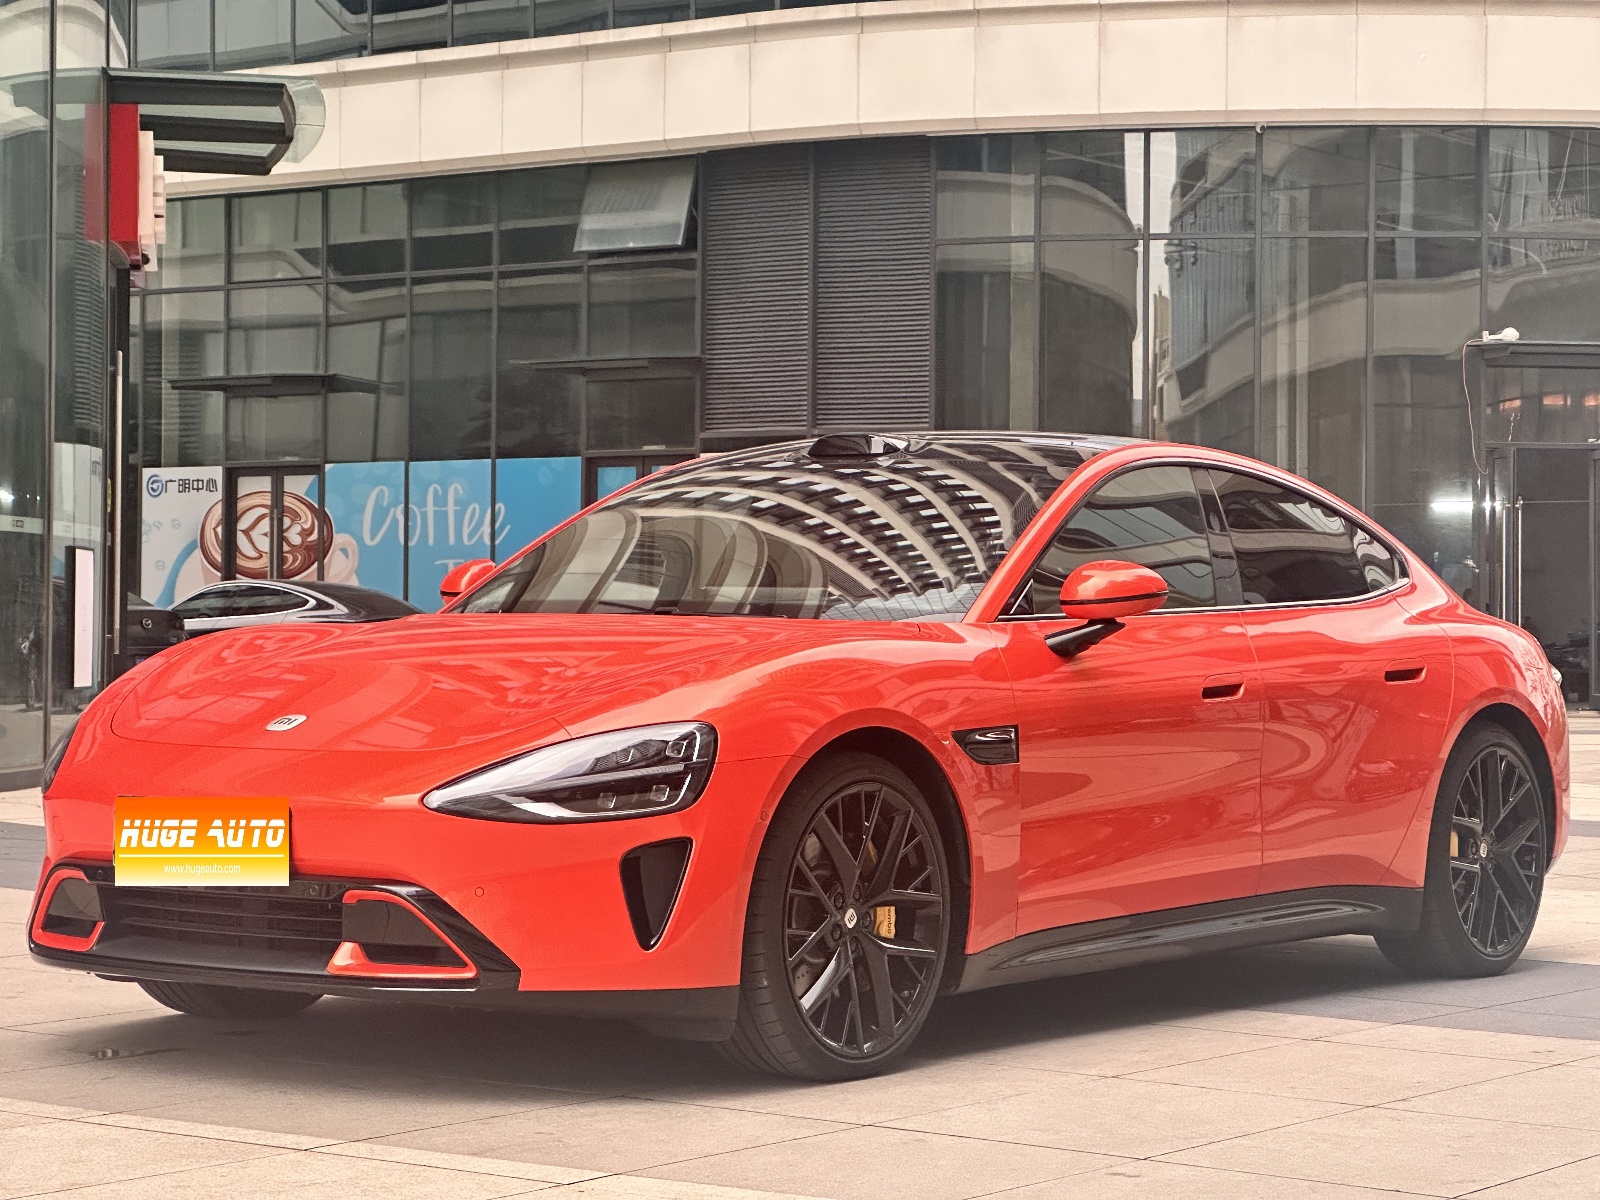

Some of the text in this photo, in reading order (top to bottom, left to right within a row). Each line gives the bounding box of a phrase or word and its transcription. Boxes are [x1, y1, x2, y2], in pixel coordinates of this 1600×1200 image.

[164, 478, 218, 493] 广明中心
[362, 482, 511, 547] Coffee
